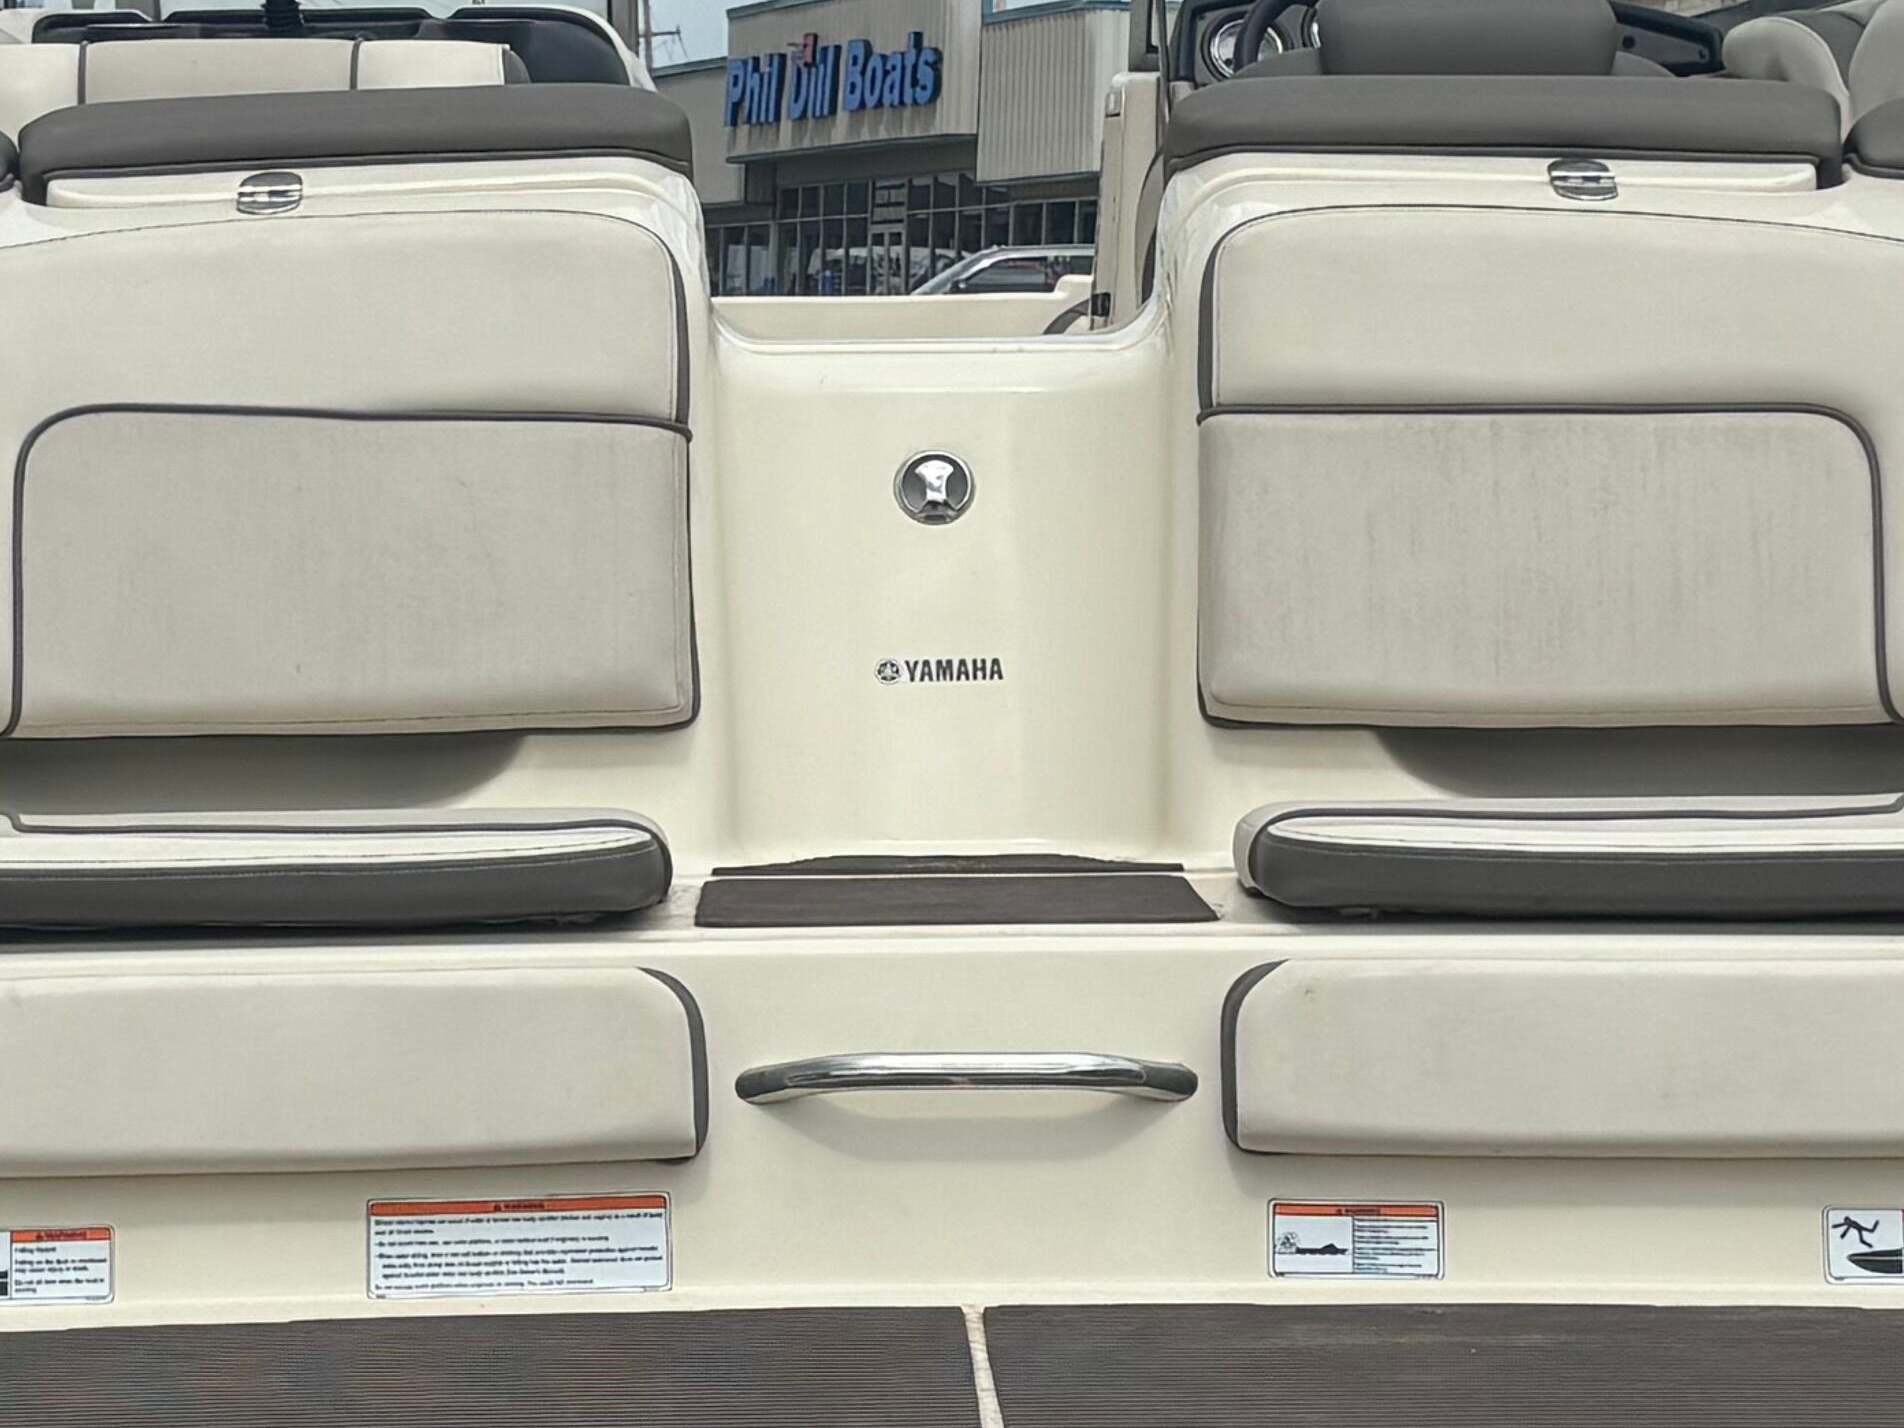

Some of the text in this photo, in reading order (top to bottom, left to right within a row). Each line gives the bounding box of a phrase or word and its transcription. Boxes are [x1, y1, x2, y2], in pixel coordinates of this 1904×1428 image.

[724, 31, 942, 128] Phil Dill Boats
[904, 657, 1004, 683] YAMAHA
